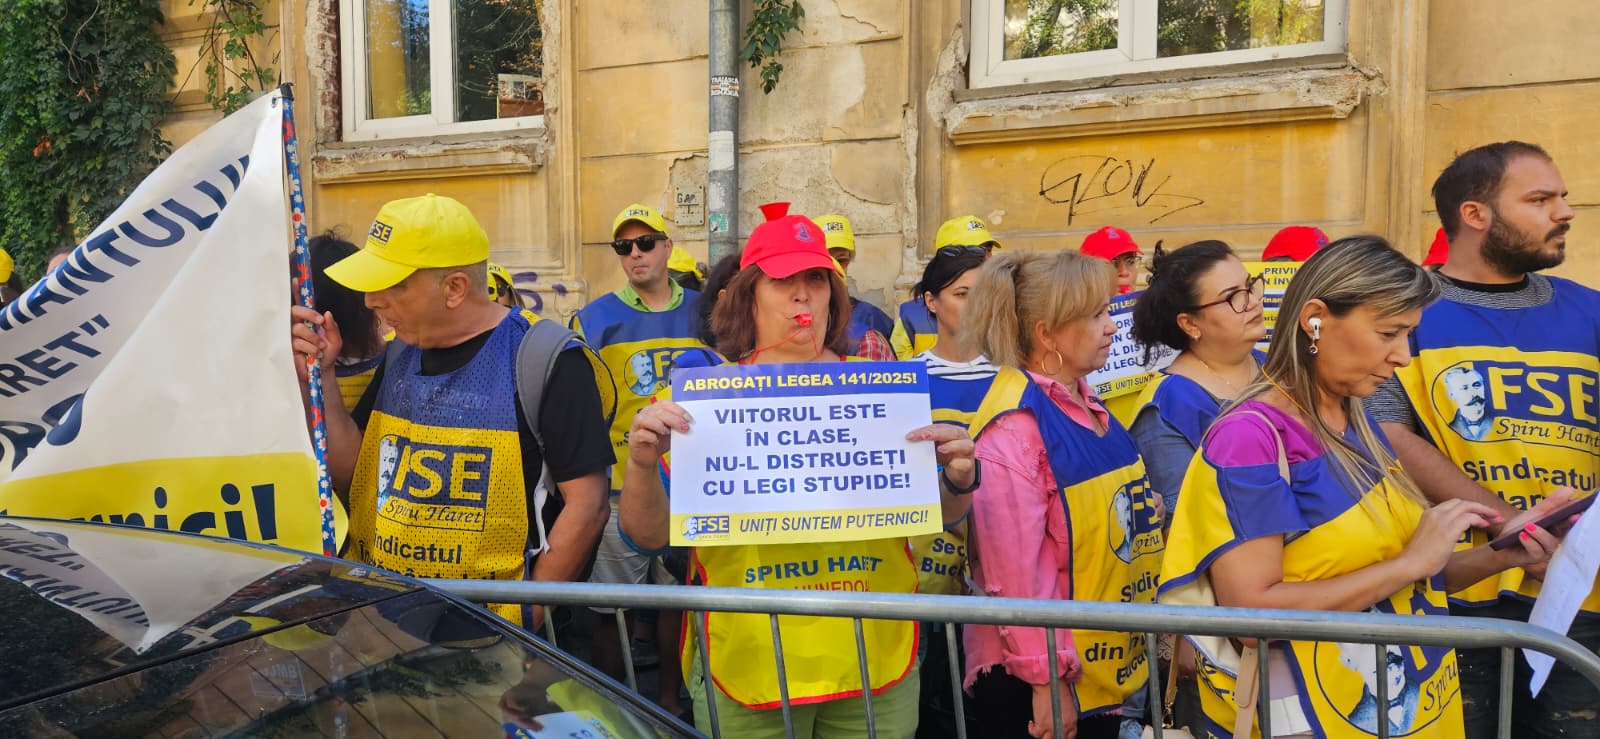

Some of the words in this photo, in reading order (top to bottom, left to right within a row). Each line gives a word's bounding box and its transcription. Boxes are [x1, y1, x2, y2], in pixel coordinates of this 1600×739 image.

[683, 375, 771, 392] ABROGAȚI
[777, 373, 834, 387] LEGEA
[838, 372, 918, 385] 141/2025!
[1487, 366, 1597, 425] FSE
[714, 406, 822, 424] VIITORUL
[829, 403, 886, 420] ESTE
[745, 428, 769, 446] ÎN
[777, 428, 857, 445] CLASE,
[1496, 418, 1550, 437] Spiru
[705, 455, 759, 472] NU-L
[767, 449, 905, 470] DISTRUGEȚI
[702, 480, 735, 496] CU
[743, 478, 796, 494] LEGI
[804, 473, 911, 493] STUPIDE!
[424, 506, 482, 524] Haret
[697, 518, 729, 532] FSE
[740, 518, 778, 535] UNIȚI
[781, 513, 842, 531] SUNTEM
[846, 510, 928, 528] PUTERNICI!
[745, 559, 819, 584] SPIRU
[1085, 642, 1123, 662] din
